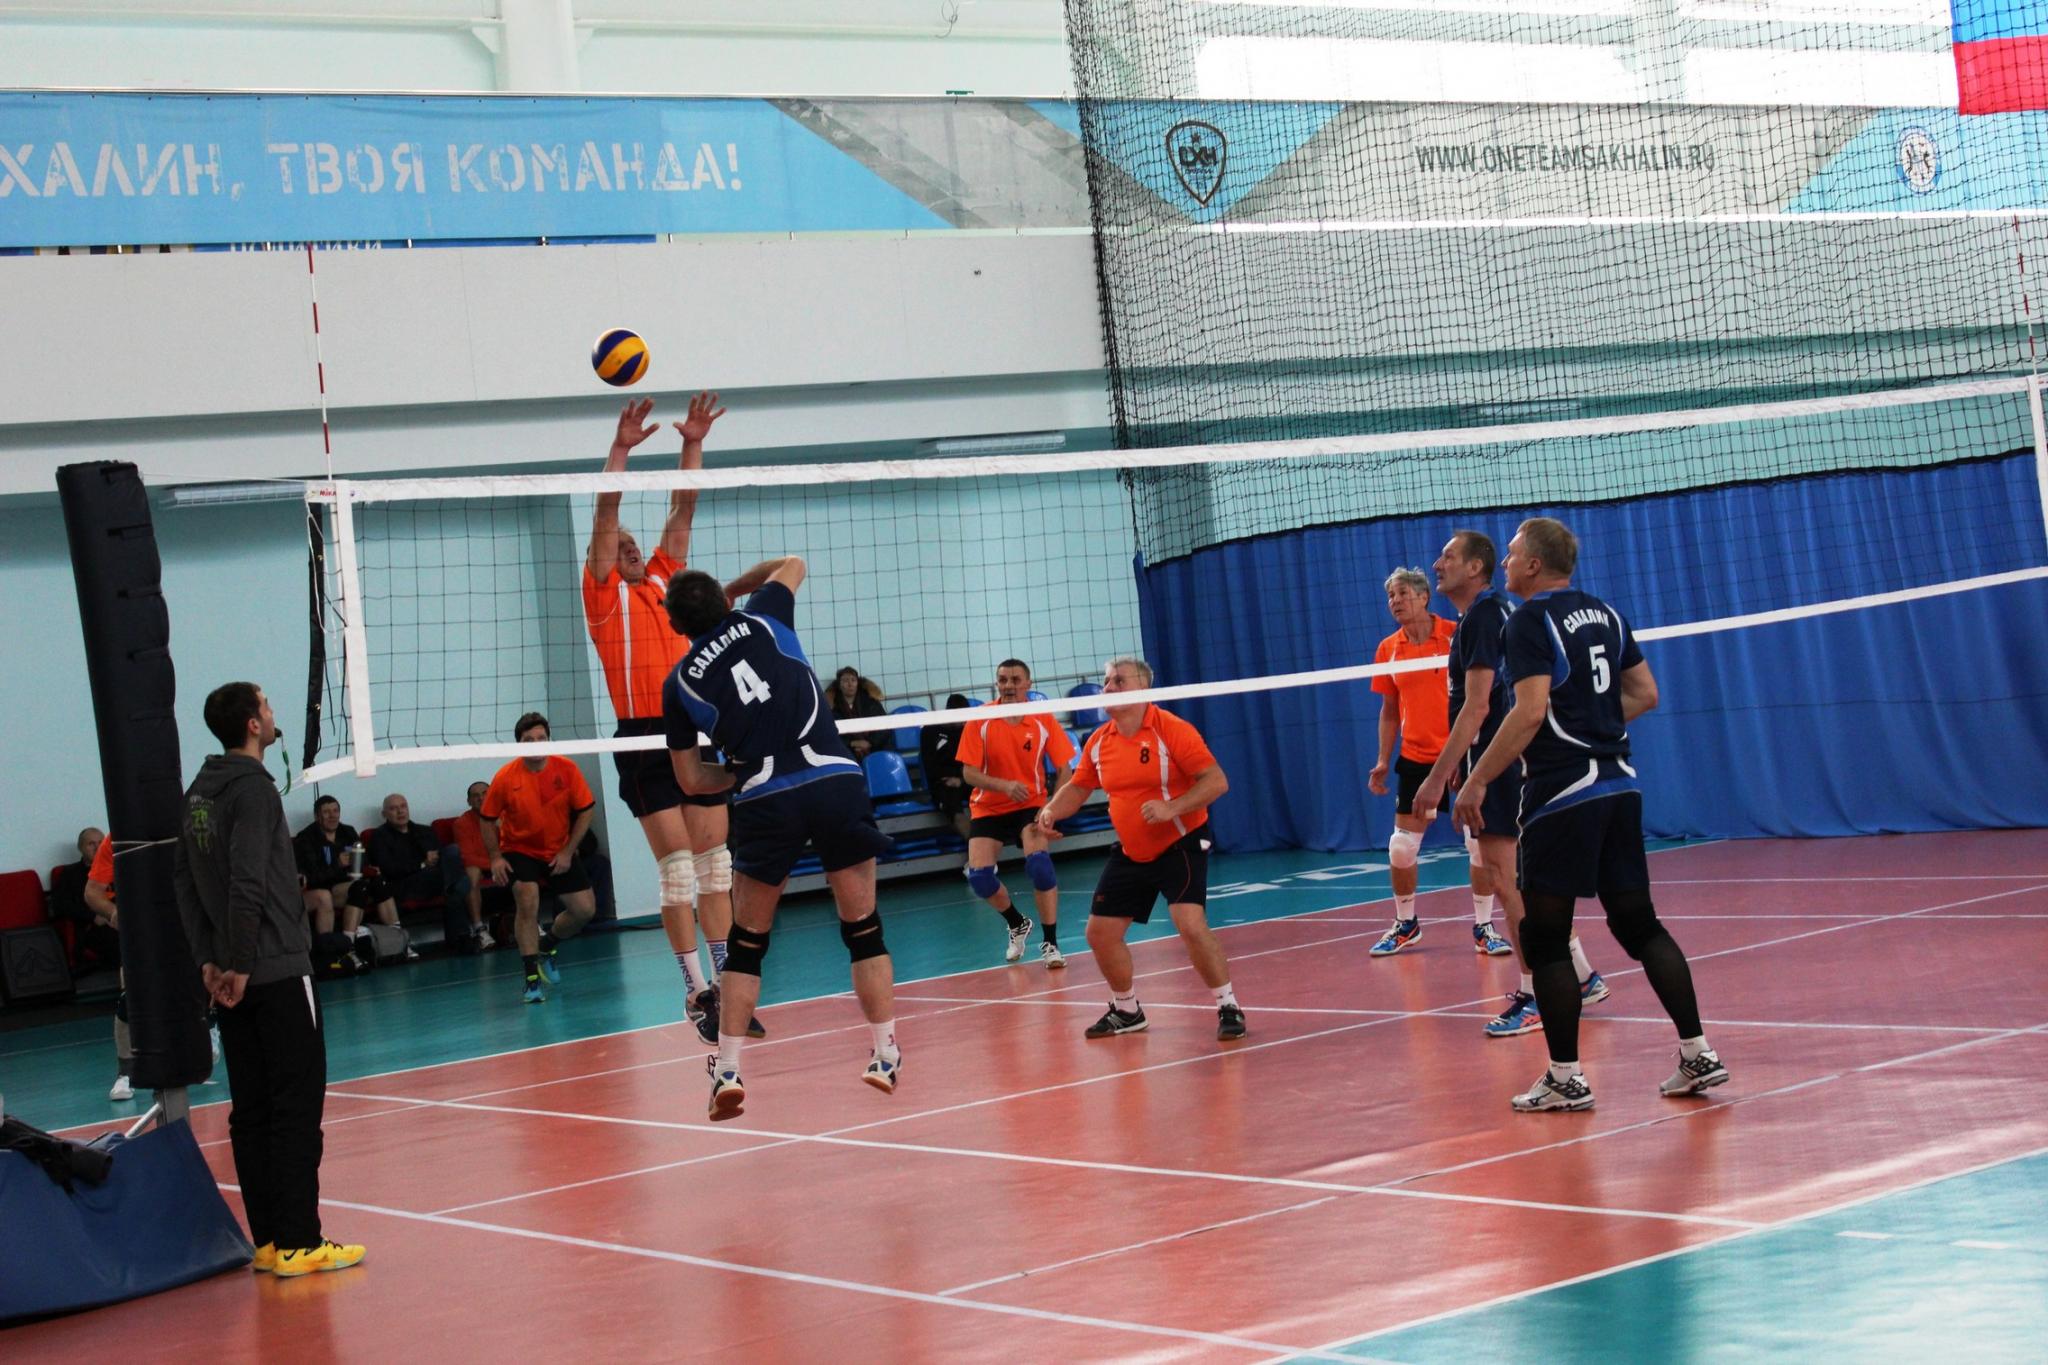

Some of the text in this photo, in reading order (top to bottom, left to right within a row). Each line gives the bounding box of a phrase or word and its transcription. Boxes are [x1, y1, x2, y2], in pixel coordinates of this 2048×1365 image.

[0, 141, 742, 200] ХАЛИН, ТВОЯ КОМАНДА!
[1415, 144, 1716, 172] WWW.ONETEAMSAKHALIN.RU
[1563, 608, 1610, 635] САХАЛИН
[688, 622, 753, 679] САХАЛИН
[1588, 644, 1611, 694] 5
[730, 658, 772, 706] 4
[1022, 739, 1032, 753] 4
[1140, 747, 1150, 765] 8
